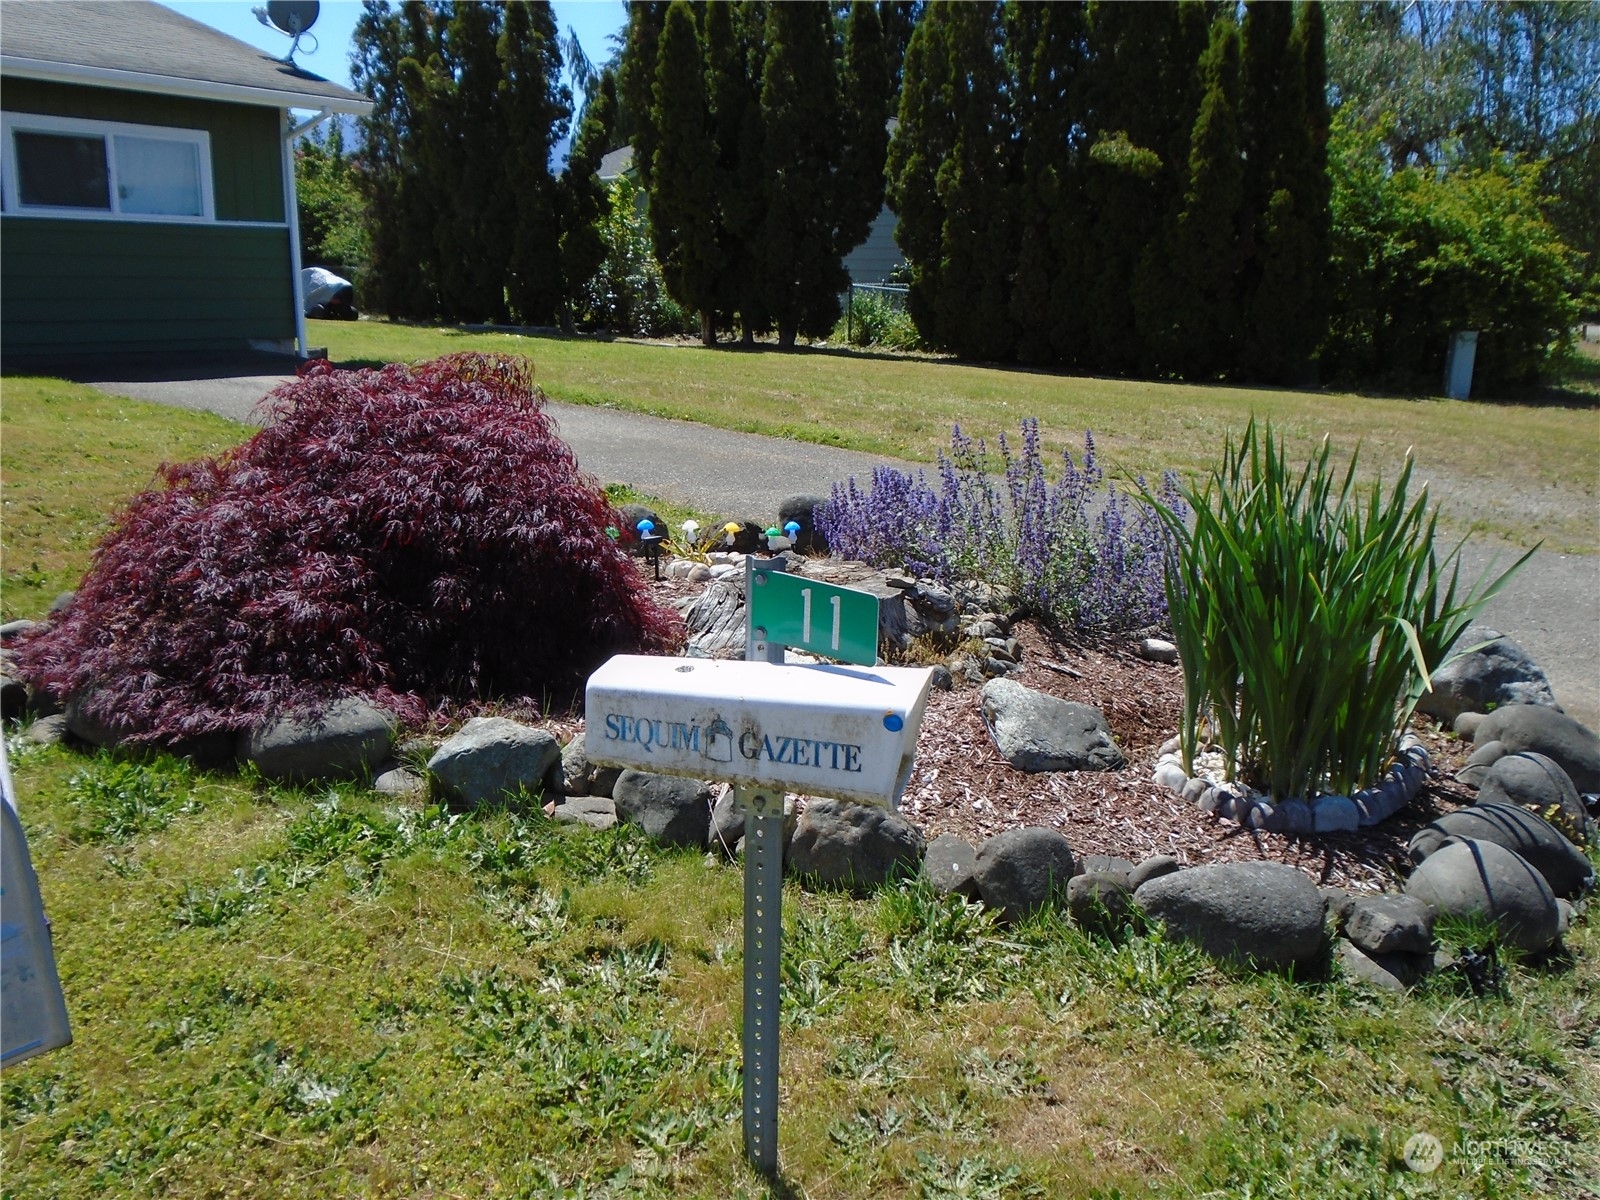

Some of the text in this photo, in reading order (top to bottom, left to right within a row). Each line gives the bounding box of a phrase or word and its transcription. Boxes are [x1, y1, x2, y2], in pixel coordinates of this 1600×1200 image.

[801, 588, 840, 650] 11
[605, 713, 862, 773] SEQUIM GAZETTE
